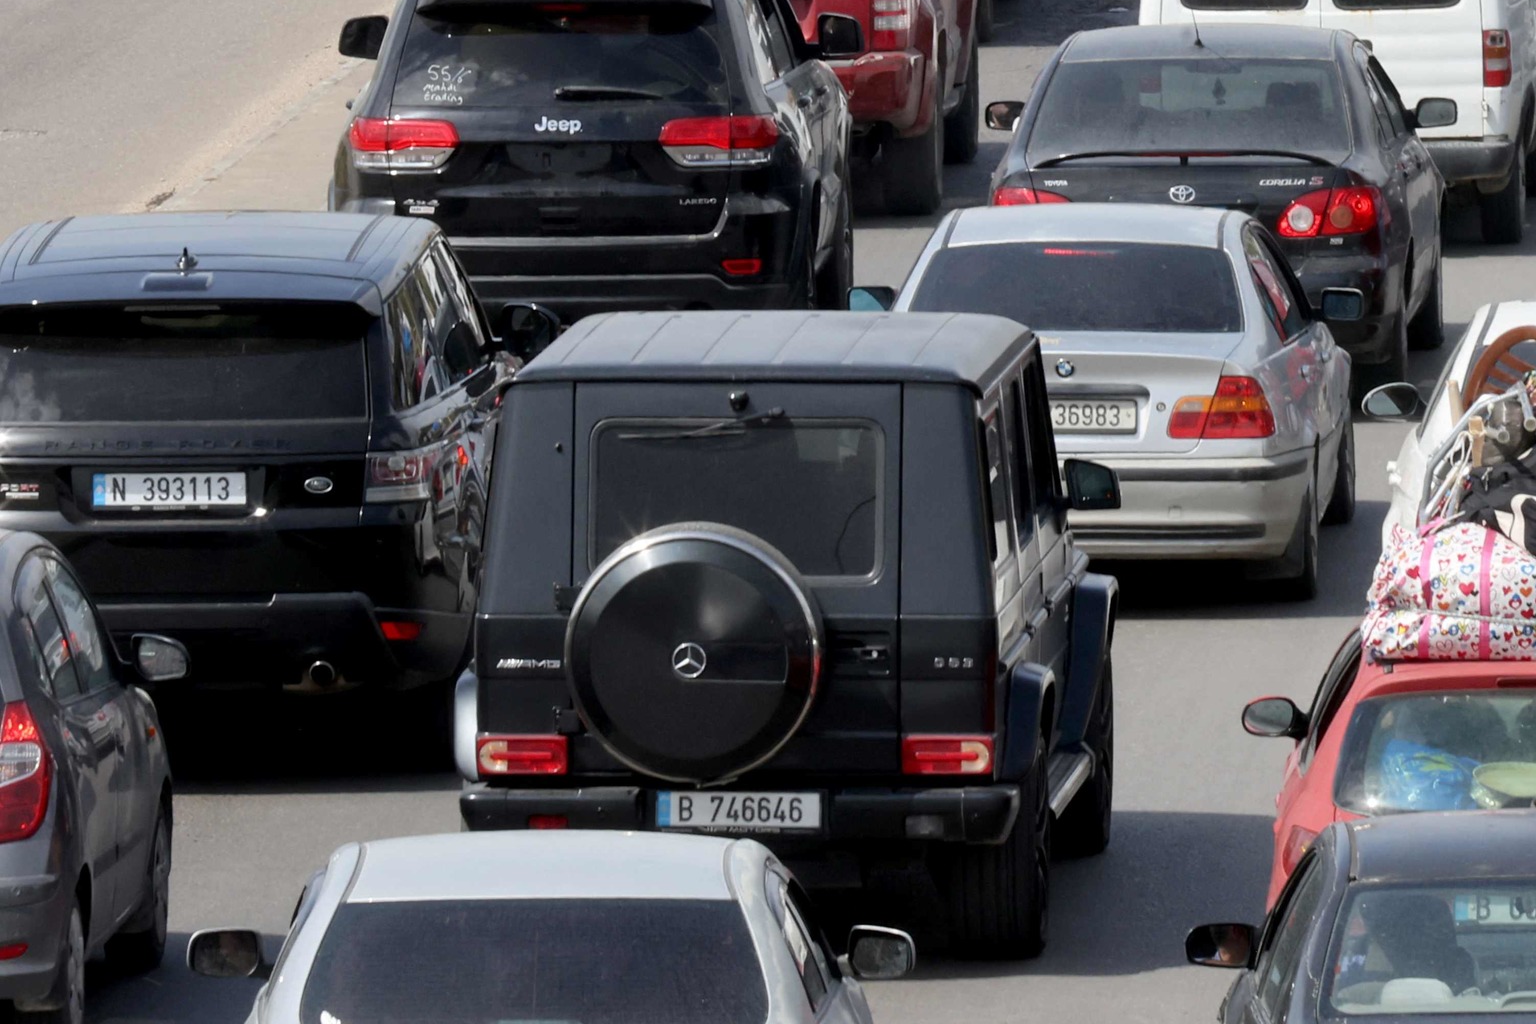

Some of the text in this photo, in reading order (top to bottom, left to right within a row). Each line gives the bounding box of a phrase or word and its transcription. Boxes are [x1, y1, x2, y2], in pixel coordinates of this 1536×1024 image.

[534, 116, 583, 135] Jeep
[1259, 176, 1324, 186] COROLLA S
[1050, 404, 1121, 426] 36983
[45, 440, 154, 451] RANGE
[112, 476, 231, 502] N 393113
[521, 659, 561, 669] AMG
[679, 796, 802, 823] B 746646
[1479, 895, 1490, 922] B
